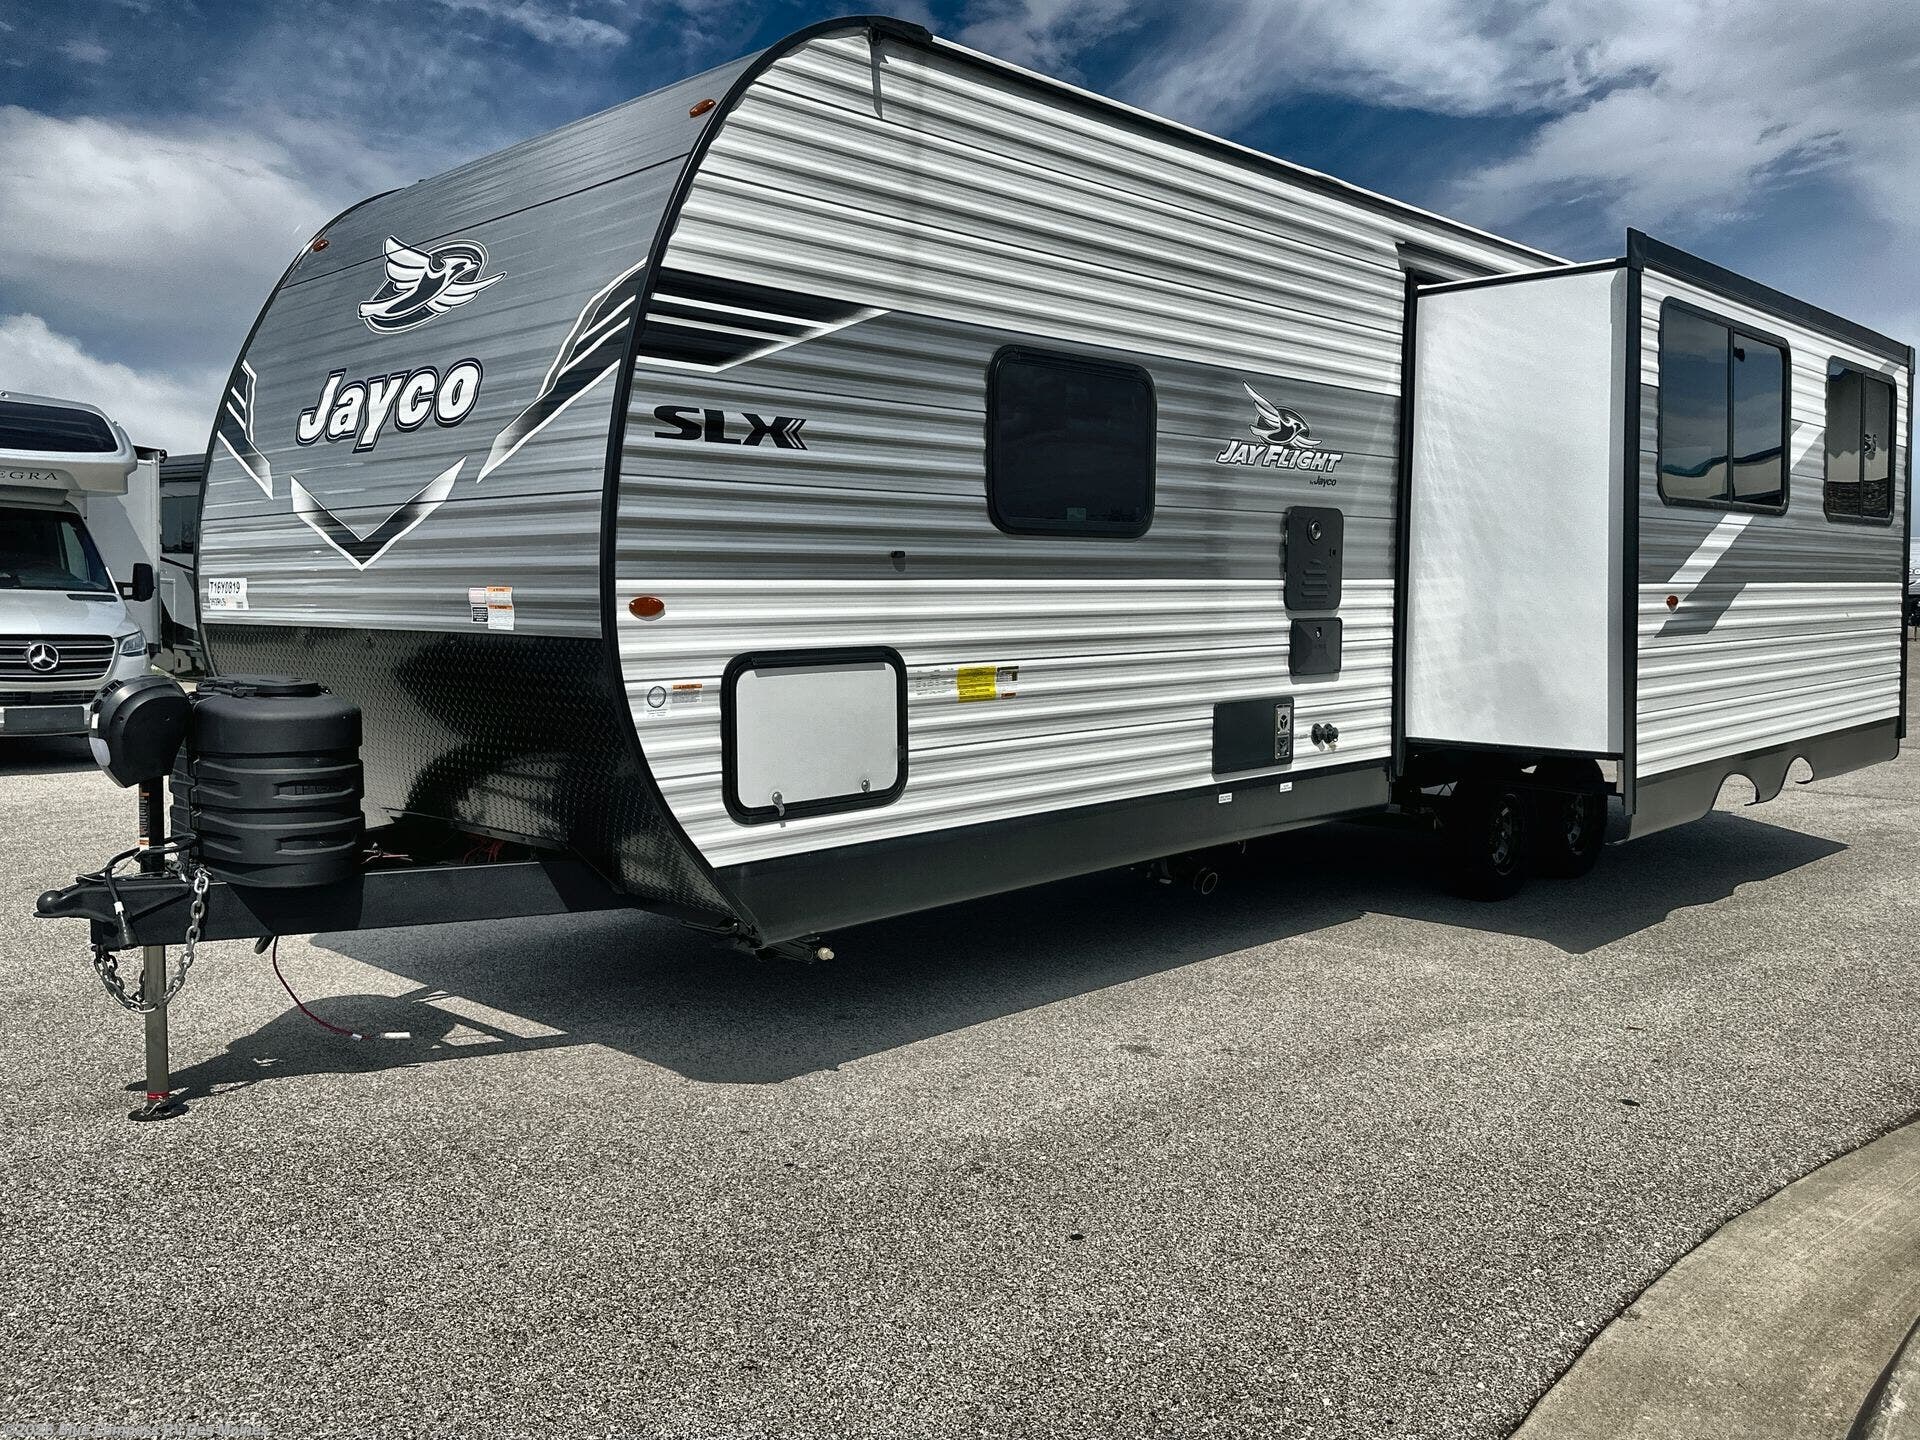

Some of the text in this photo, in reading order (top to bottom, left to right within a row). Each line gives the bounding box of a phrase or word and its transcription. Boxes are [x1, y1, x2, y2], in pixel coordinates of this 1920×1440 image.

[296, 357, 484, 454] Jayco
[653, 405, 808, 450] SLX
[1216, 439, 1343, 473] JAY FLIGHT
[1313, 475, 1337, 488] Jayco
